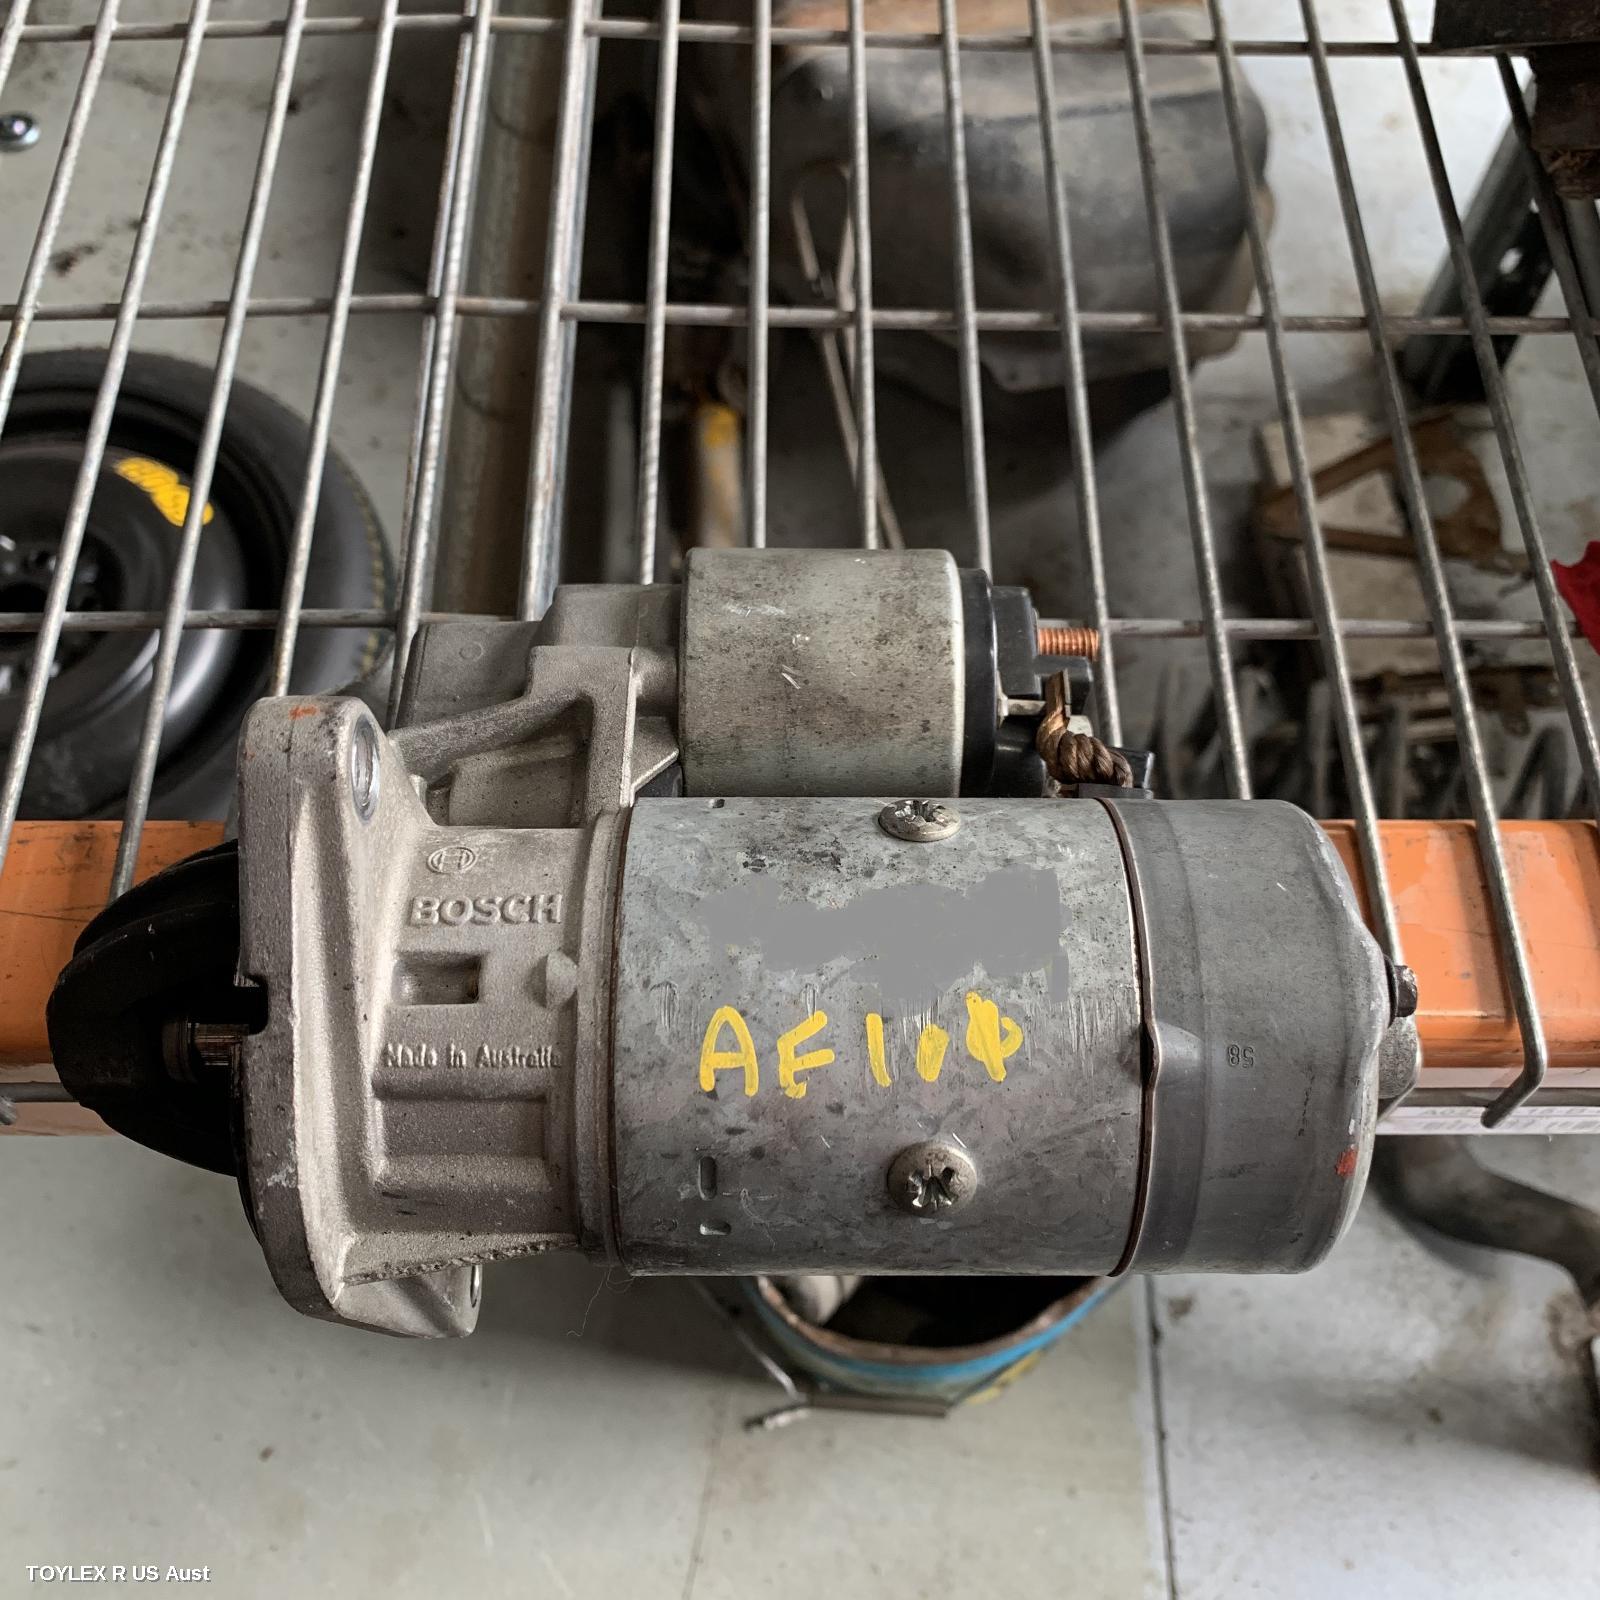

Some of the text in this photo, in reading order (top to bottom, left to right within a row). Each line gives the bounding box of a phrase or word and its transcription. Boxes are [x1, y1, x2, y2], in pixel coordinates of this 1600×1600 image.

[408, 894, 563, 927] BOSCH
[381, 1041, 563, 1069] Made in Australia
[1227, 1044, 1254, 1069] 58
